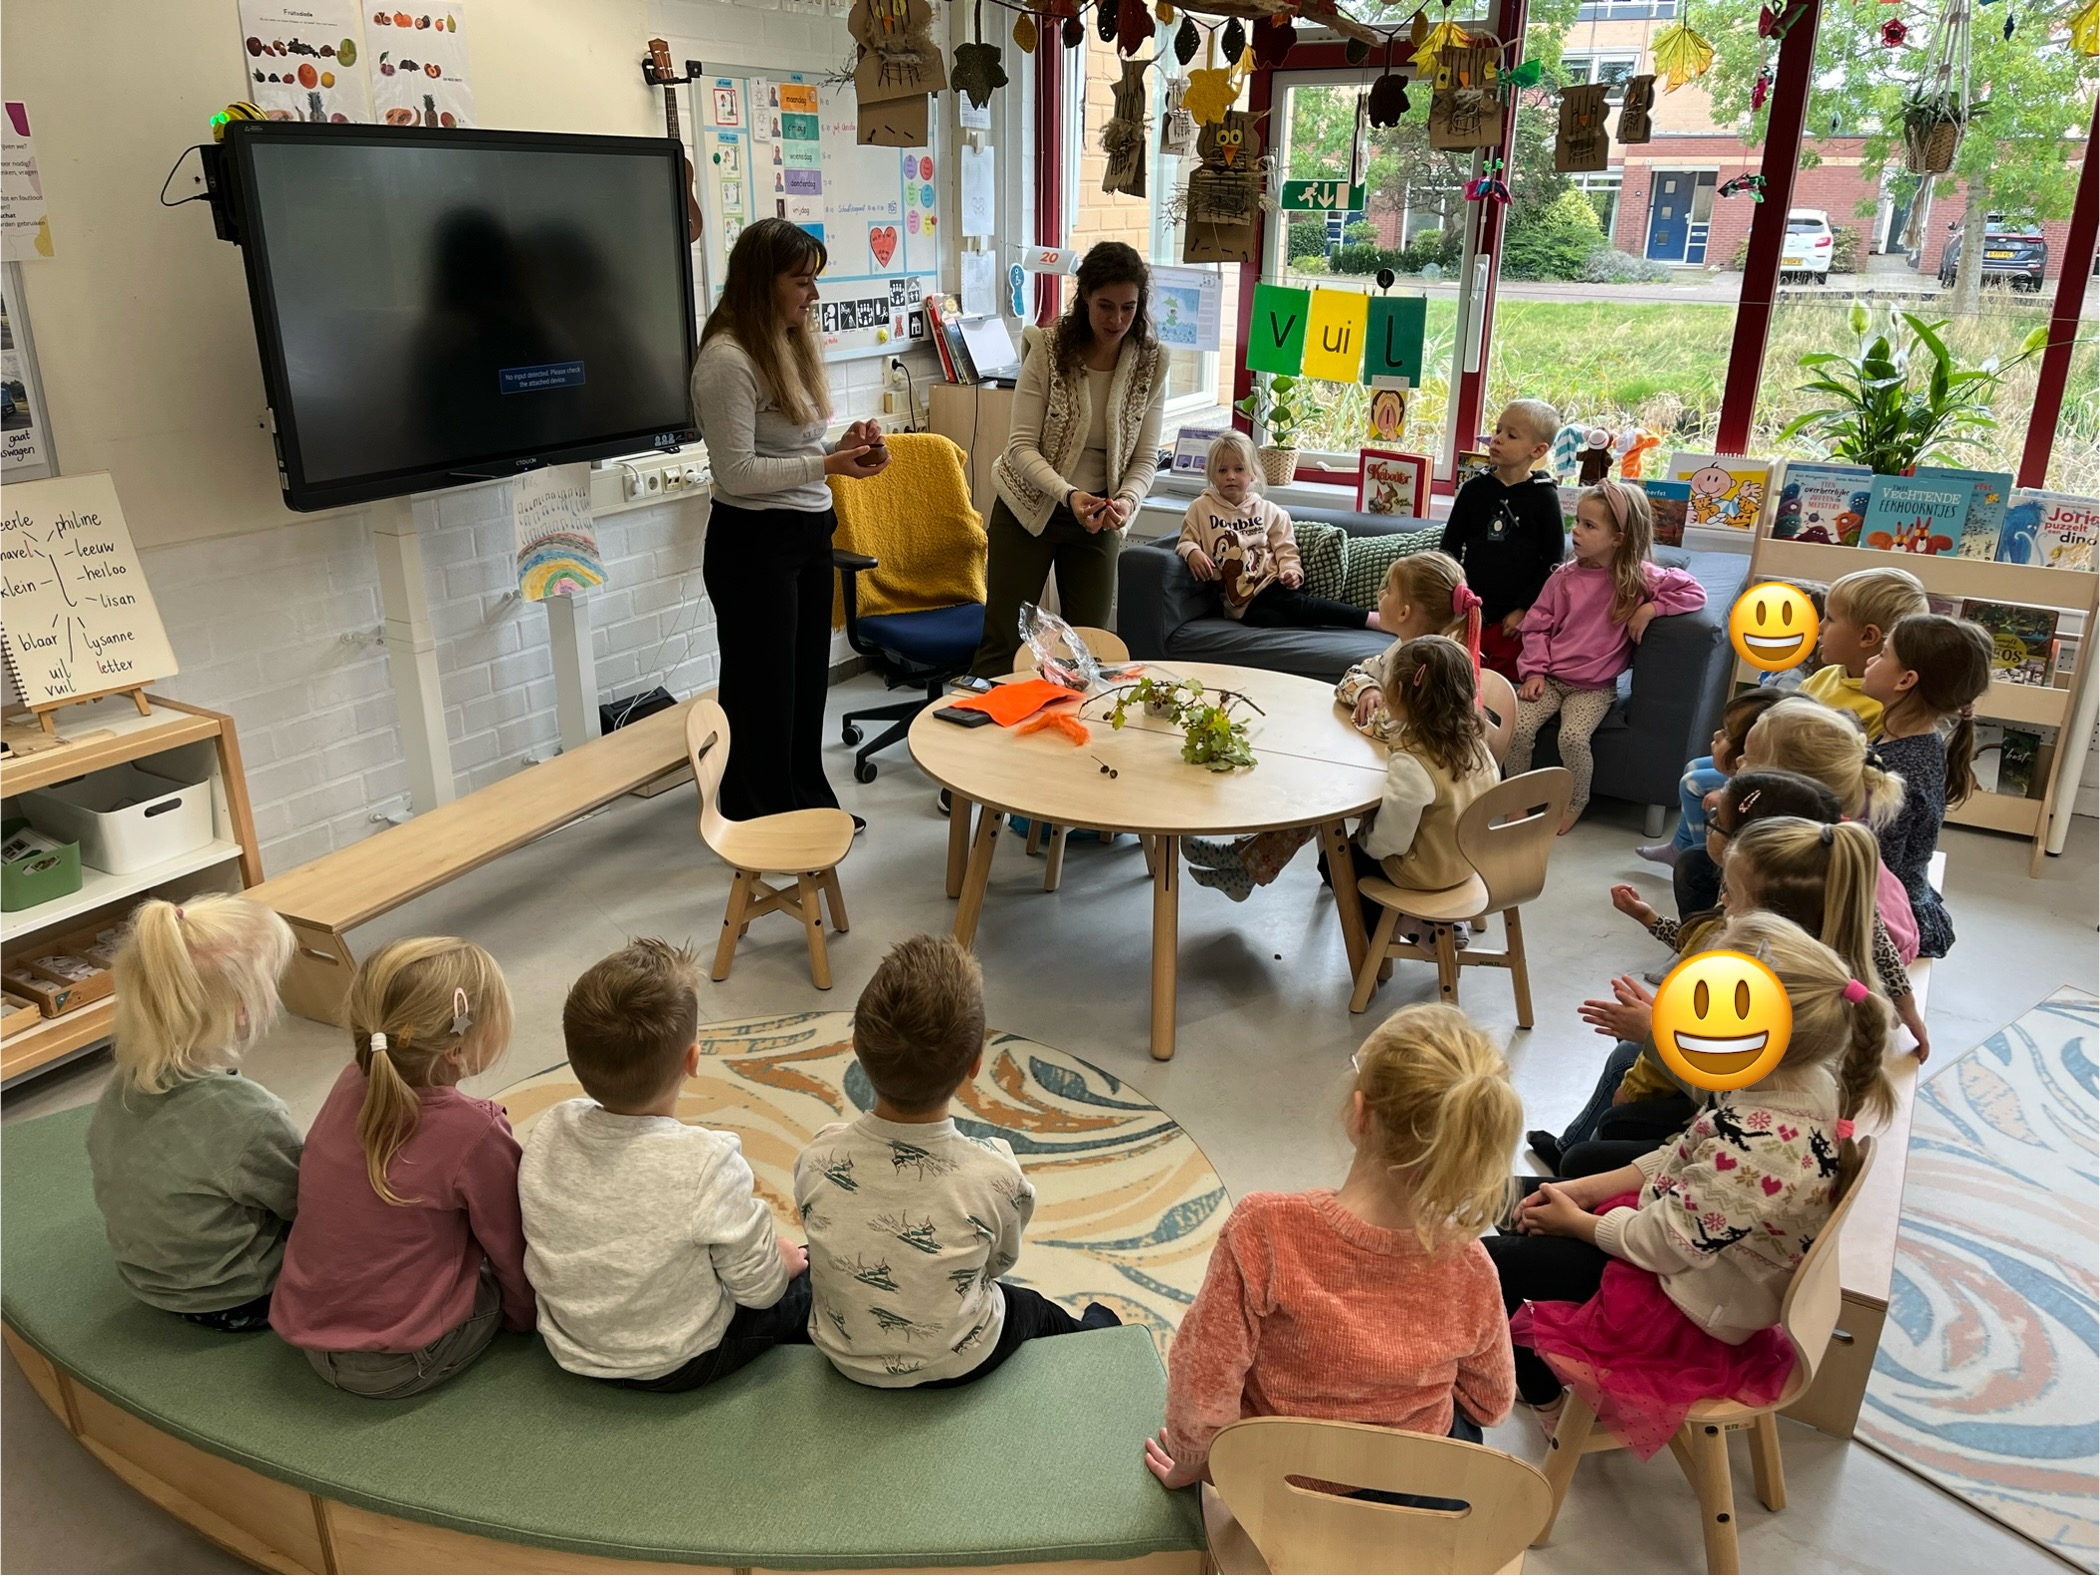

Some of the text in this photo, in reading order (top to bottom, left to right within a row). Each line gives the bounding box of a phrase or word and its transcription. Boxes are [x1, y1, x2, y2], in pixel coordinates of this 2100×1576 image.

[789, 152, 813, 163] woensdag
[789, 179, 816, 190] donderdag
[1039, 251, 1060, 264] 20
[1322, 320, 1352, 355] ui
[1384, 314, 1403, 368] l
[514, 373, 527, 381] input
[550, 367, 566, 376] Please
[566, 365, 581, 374] check
[519, 380, 528, 388] the
[528, 378, 550, 387] attached
[9, 429, 31, 448] gaat
[515, 458, 537, 466] CTOUCH
[1883, 487, 1962, 505] VECHTENDE
[1808, 501, 1841, 510] MEESTERS
[1879, 500, 1959, 519] EEKHOORNTJES
[55, 511, 102, 539] philine
[1208, 514, 1264, 531] Double
[2044, 522, 2089, 533] puzzelt
[2059, 531, 2098, 547] dino
[74, 538, 115, 558] leeuw
[83, 561, 127, 582] heiloo
[99, 593, 136, 609] lisan
[18, 632, 58, 652] blaar
[82, 631, 136, 657] lysanne
[49, 658, 72, 679] uil
[96, 659, 134, 675] letter
[44, 678, 77, 697] vuil
